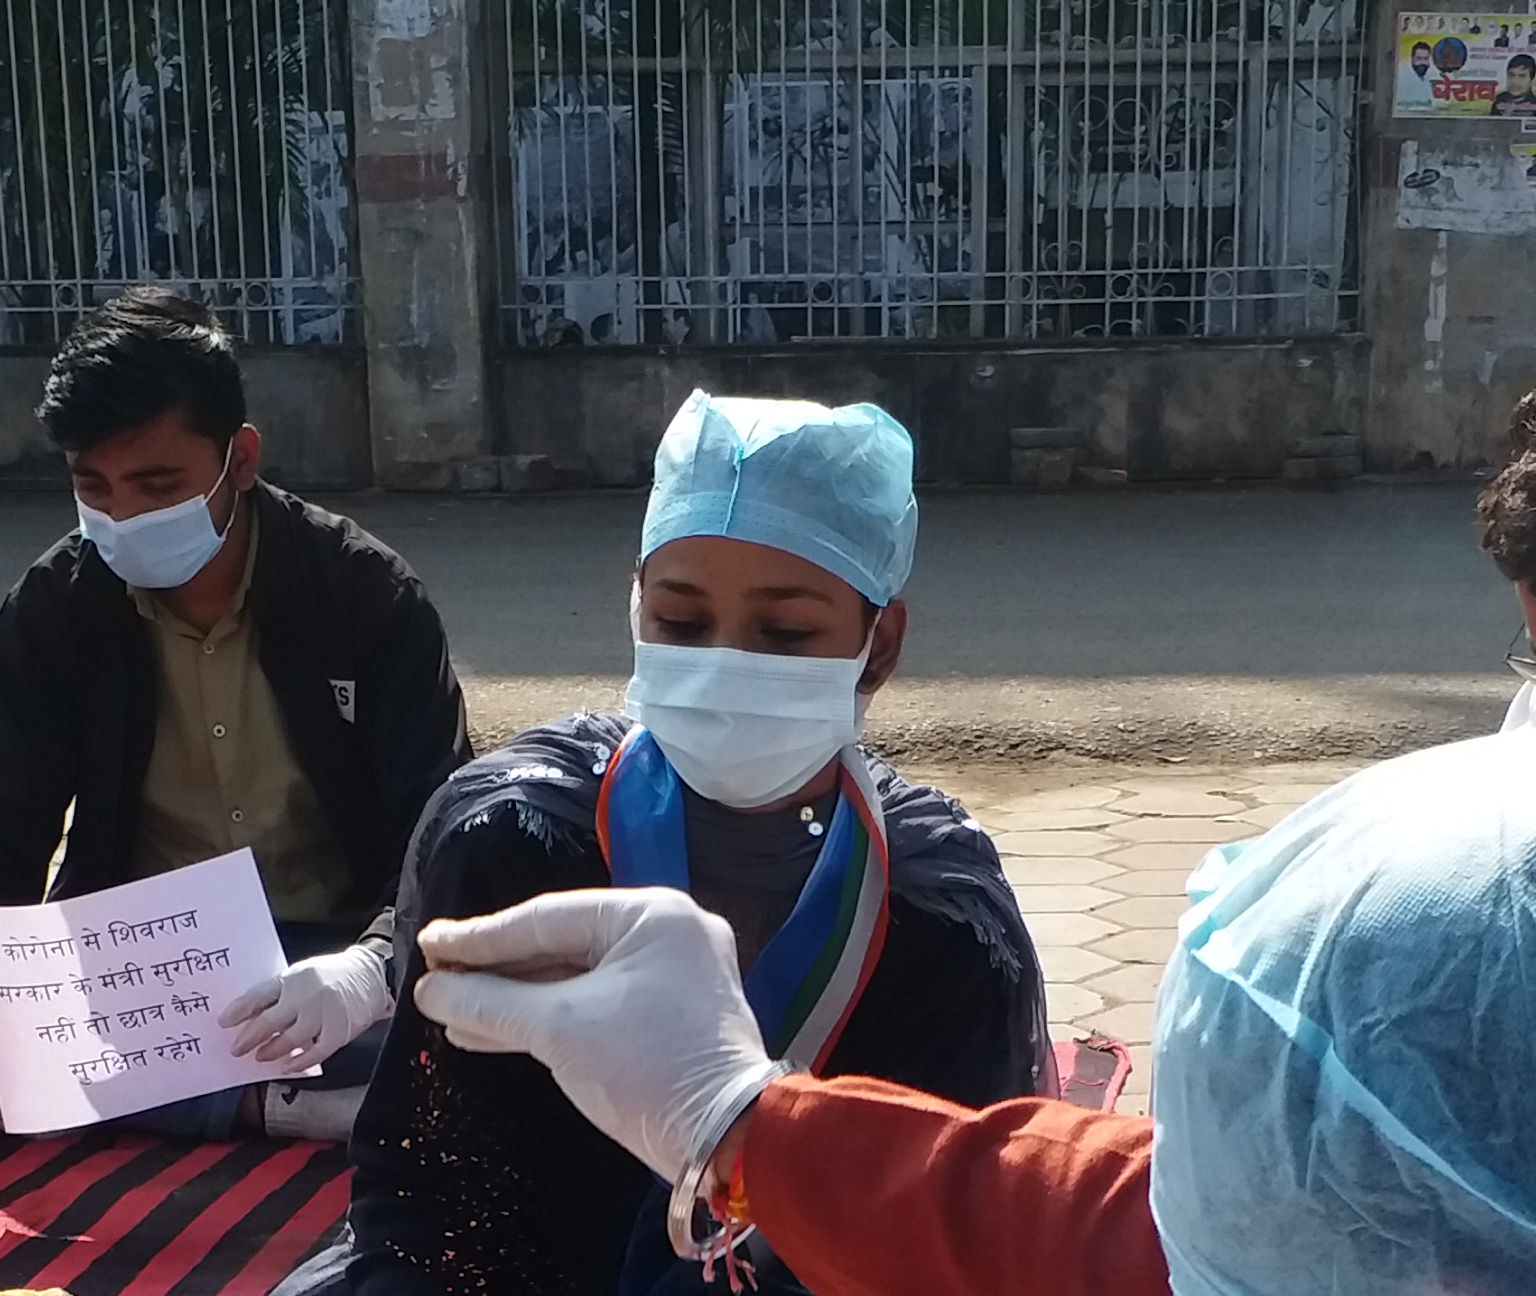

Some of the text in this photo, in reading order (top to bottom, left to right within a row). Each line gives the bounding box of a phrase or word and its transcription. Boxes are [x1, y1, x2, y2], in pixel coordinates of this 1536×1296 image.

[2, 909, 198, 961] कोरोना से शिवराज
[71, 973, 92, 997] के
[97, 962, 144, 990] मंत्री
[150, 947, 230, 987] सुरक्षित
[83, 1011, 110, 1035] तो
[117, 1004, 165, 1029] छात्र
[171, 991, 210, 1016] कैसे
[69, 1049, 147, 1086] सुरक्षित
